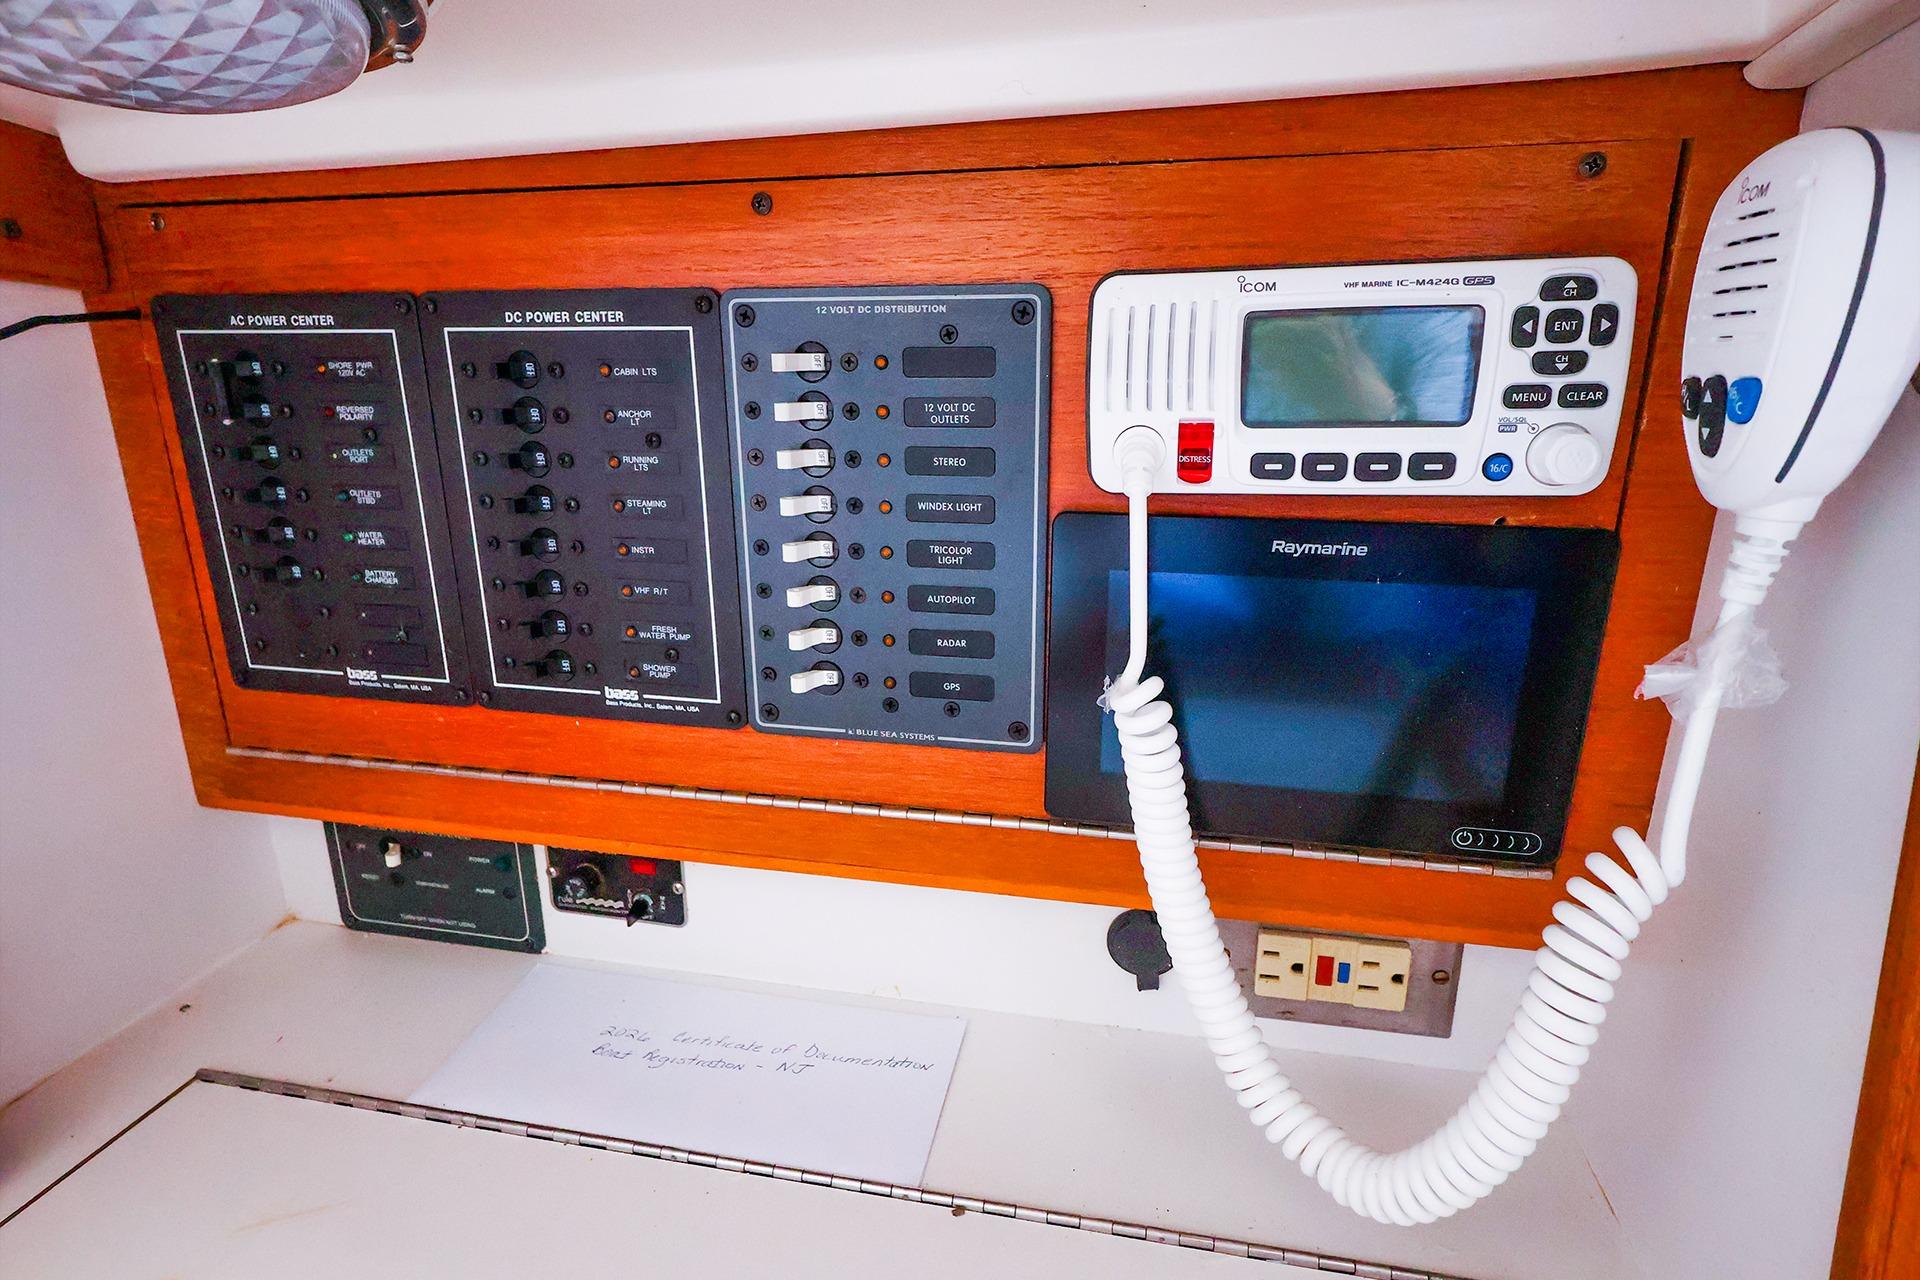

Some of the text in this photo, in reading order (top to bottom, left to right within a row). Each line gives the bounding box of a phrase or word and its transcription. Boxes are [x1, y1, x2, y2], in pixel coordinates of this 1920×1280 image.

[1344, 276, 1495, 289] VHF MARINE IC-M424G GPS
[1563, 288, 1577, 297] CH
[816, 305, 947, 314] 12 VOLT DC DISTRIBUTION
[230, 315, 334, 326] AC POWER CENTER
[505, 311, 624, 323] DC POWER CENTER
[1553, 319, 1578, 332] ENT
[1555, 354, 1569, 363] CH
[328, 361, 373, 369] SHORE PWR
[525, 363, 536, 377] OFF
[613, 367, 657, 376] CABIN LTS
[1511, 391, 1547, 402] MENU
[1566, 390, 1603, 401] CLEAR
[336, 405, 374, 414] REVERSED
[924, 403, 976, 413] 12 VOLT DC
[530, 408, 540, 421] OFF
[617, 410, 652, 419] ANCHOR
[930, 414, 970, 424] OUTLETS
[630, 418, 640, 426] LT
[1498, 416, 1528, 424] VOL/SQL
[1499, 424, 1517, 432] PWR
[342, 448, 374, 456] OUTLETS
[536, 452, 546, 465] OFF
[622, 456, 659, 465] RUNNING
[933, 457, 967, 467] STEREO
[1178, 454, 1212, 464] DISTRESS
[634, 463, 649, 472] LTS
[1489, 463, 1509, 474] 16/C
[349, 489, 381, 498] OUTLETS
[541, 496, 551, 510] OFF
[627, 499, 667, 509] STEAMING
[917, 502, 983, 513] WINDEX LIGHT
[643, 507, 652, 515] LT
[357, 531, 383, 539] WATER
[357, 538, 386, 546] HEATER
[547, 539, 557, 552] OFF
[631, 546, 655, 555] INSTR
[929, 545, 973, 555] TRICOLOR
[1271, 540, 1368, 558] Raymarine
[937, 555, 964, 566] LIGHT
[364, 569, 396, 578] BATTERY
[364, 576, 399, 585] CHARGER
[551, 580, 561, 593] OFF
[634, 586, 669, 596] VHF R/T
[927, 595, 976, 605] AUTOPILOT
[557, 620, 567, 633] OFF
[651, 625, 677, 634] FRESH
[639, 631, 691, 641] WATER PUMP
[936, 638, 967, 648] RADAR
[562, 660, 571, 673] OFF
[642, 663, 677, 674] SHOWER
[346, 667, 378, 681] bass
[649, 670, 671, 680] PUMP
[943, 682, 961, 692] GPS
[604, 686, 639, 701] bass
[856, 728, 935, 741] BLUE SEA SYSTEMS
[672, 1031, 763, 1053] Certificate
[771, 1043, 798, 1055] of
[803, 1043, 935, 1072] Documentation
[642, 1048, 746, 1072] Registration
[775, 1061, 815, 1075] NJ
